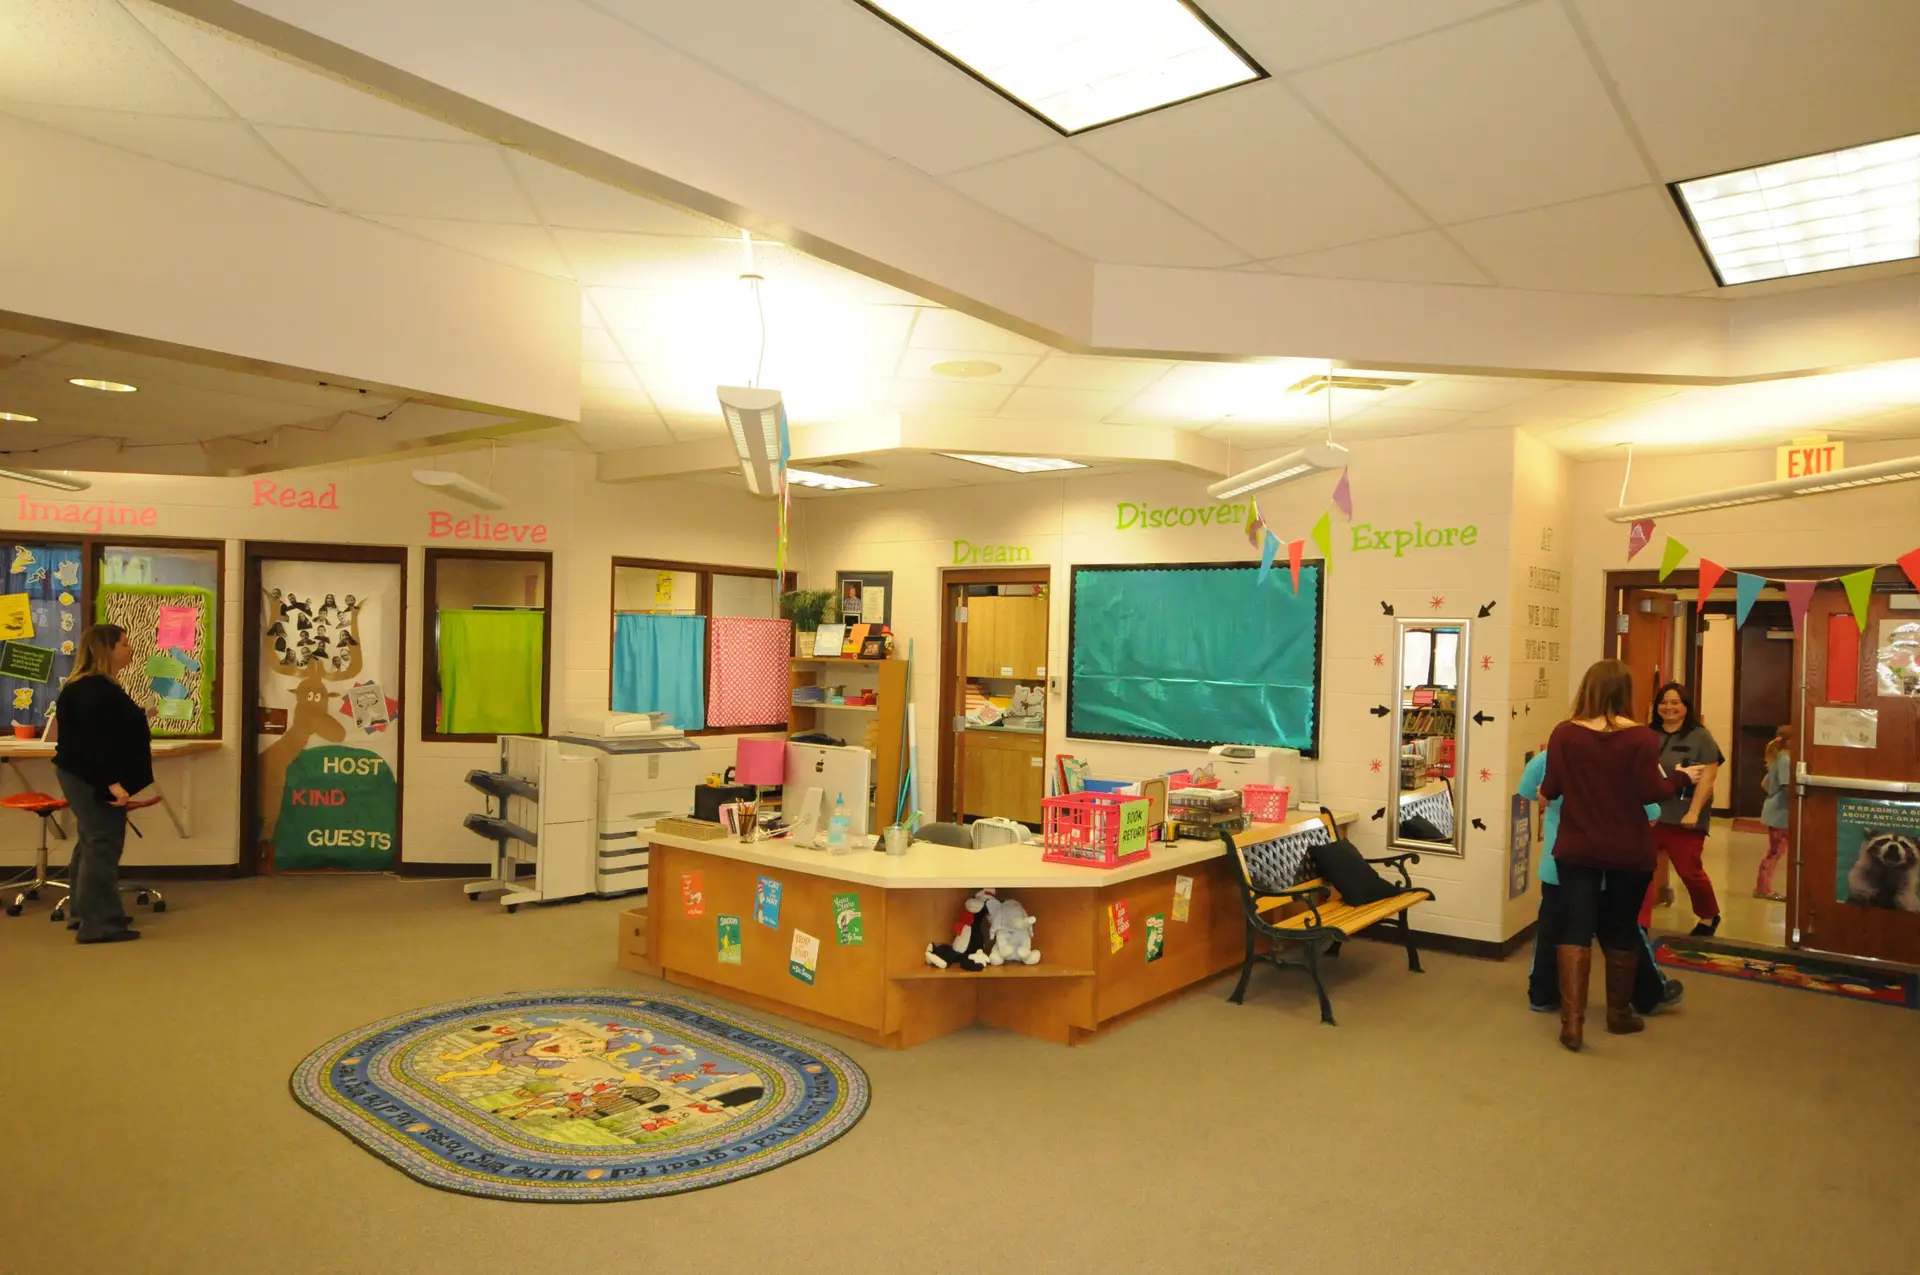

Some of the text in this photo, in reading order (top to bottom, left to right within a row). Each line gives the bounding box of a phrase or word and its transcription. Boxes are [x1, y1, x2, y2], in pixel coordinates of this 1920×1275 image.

[1788, 446, 1836, 478] EXIT
[252, 480, 338, 510] Read
[17, 494, 158, 533] Imagine
[1116, 502, 1246, 530] Discover
[427, 510, 548, 544] Believe
[1351, 521, 1478, 558] Explore
[953, 540, 1031, 564] Dream
[323, 757, 384, 775] HOST
[292, 789, 347, 807] KIND
[1126, 810, 1143, 825] BOOK
[1857, 806, 1899, 814] READING
[307, 829, 392, 850] GUESTS
[1122, 825, 1146, 842] RETURN
[420, 1127, 467, 1155] horses
[750, 1129, 795, 1148] had
[511, 1165, 552, 1178] the
[656, 1150, 729, 1174] great
[552, 1169, 582, 1181] All
[609, 1167, 650, 1179] fall
